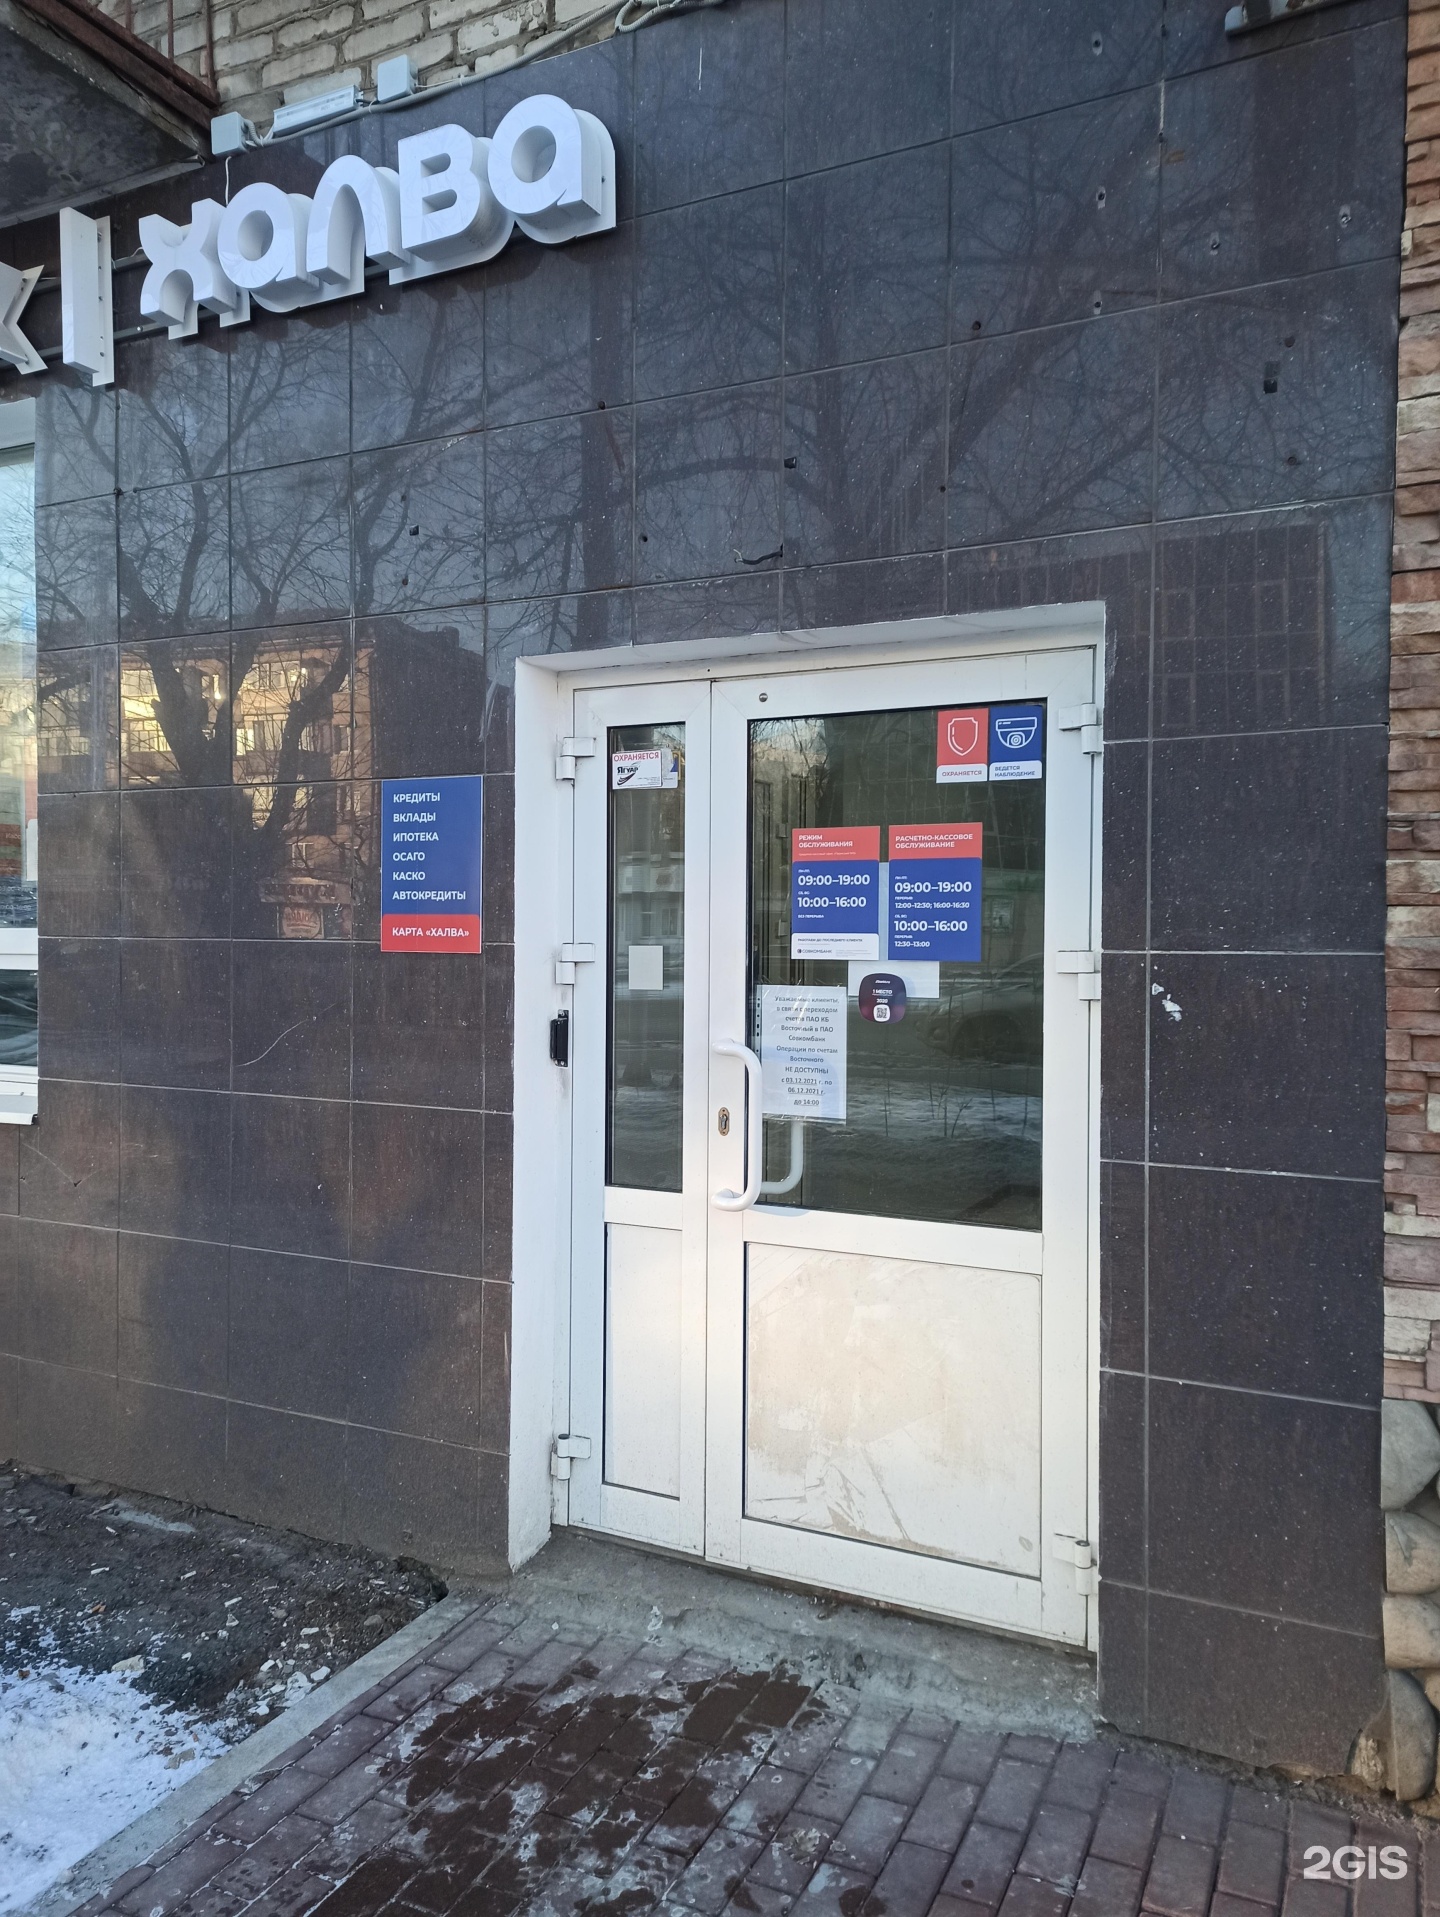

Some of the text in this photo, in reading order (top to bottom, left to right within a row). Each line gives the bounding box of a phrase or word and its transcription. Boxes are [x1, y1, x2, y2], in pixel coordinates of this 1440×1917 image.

[613, 752, 659, 762] ОХРАНЯЕТСЯ
[393, 792, 440, 803] КРЕДИТЫ
[393, 812, 436, 823] ВКЛАДЫ
[393, 832, 439, 842] ИПОТЕКА
[393, 852, 425, 861] ОСАГО
[393, 871, 426, 880] КАСКО
[392, 891, 466, 901] АВТОКРЕДИТЫ
[392, 927, 469, 937] КАРТА «ХАЛВА»
